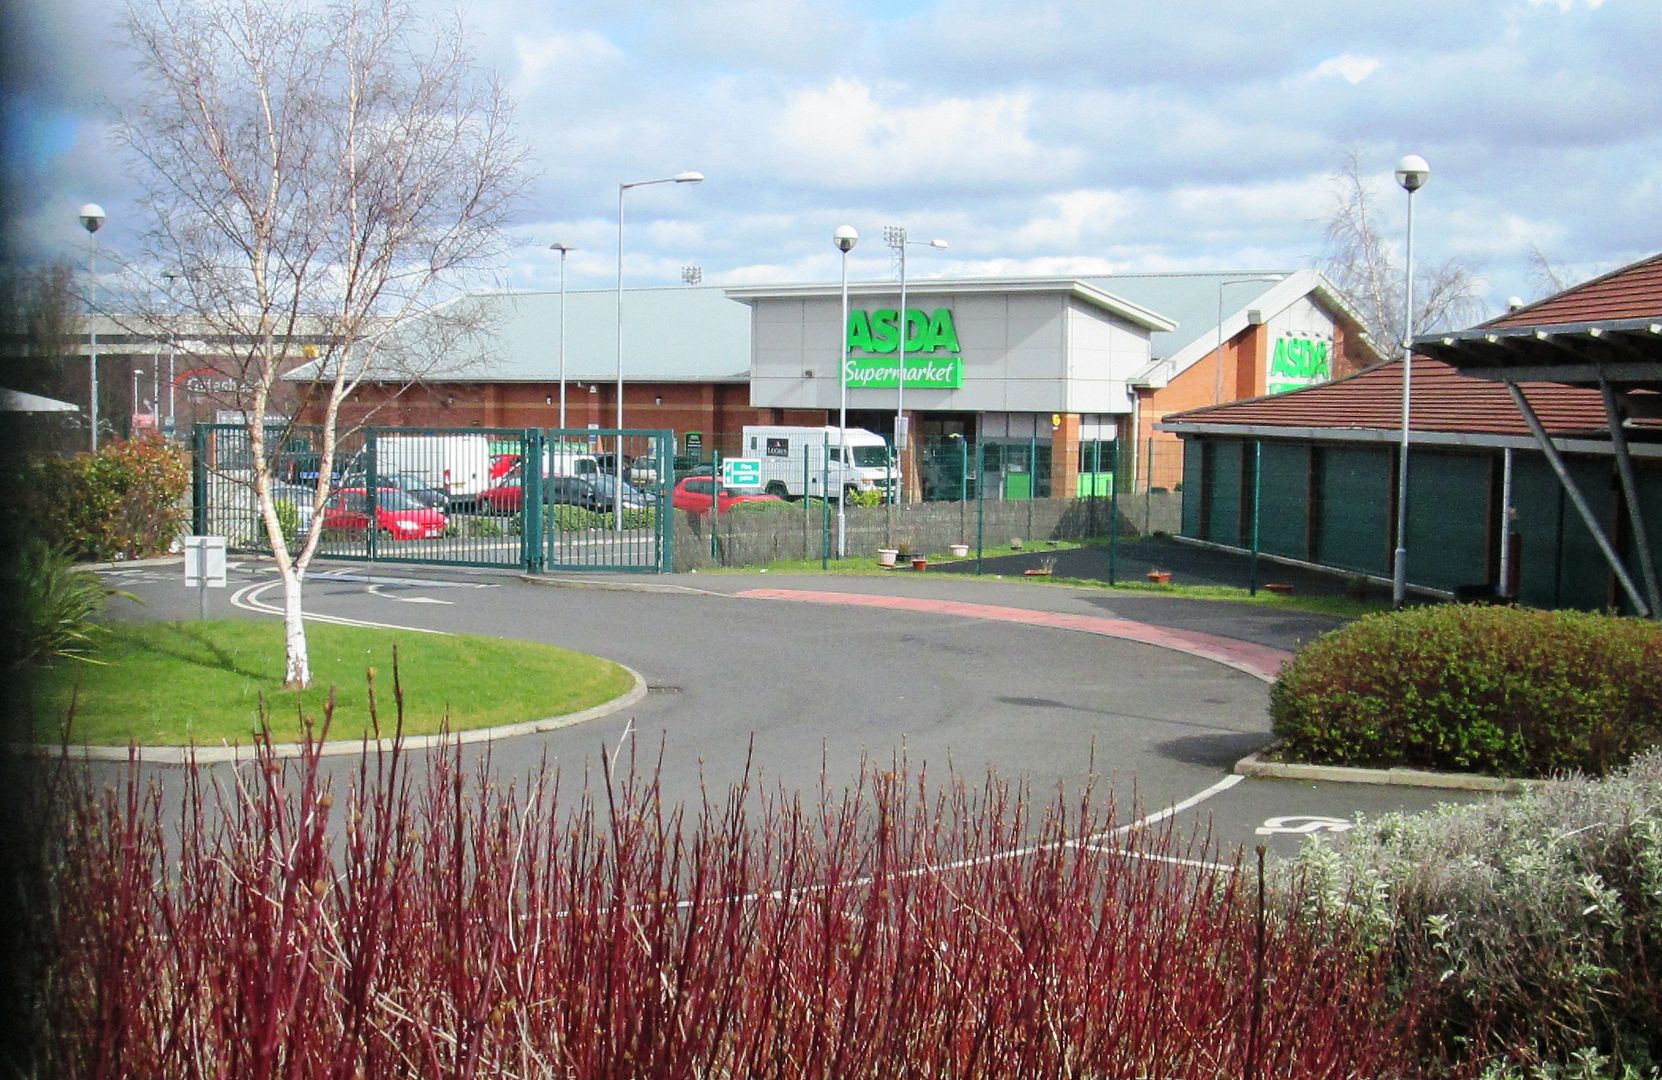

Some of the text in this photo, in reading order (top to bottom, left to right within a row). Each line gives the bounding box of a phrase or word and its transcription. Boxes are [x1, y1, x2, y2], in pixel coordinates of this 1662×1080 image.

[846, 308, 960, 353] ASDA
[845, 360, 954, 386] Supermarket
[1271, 338, 1329, 379] ASDA
